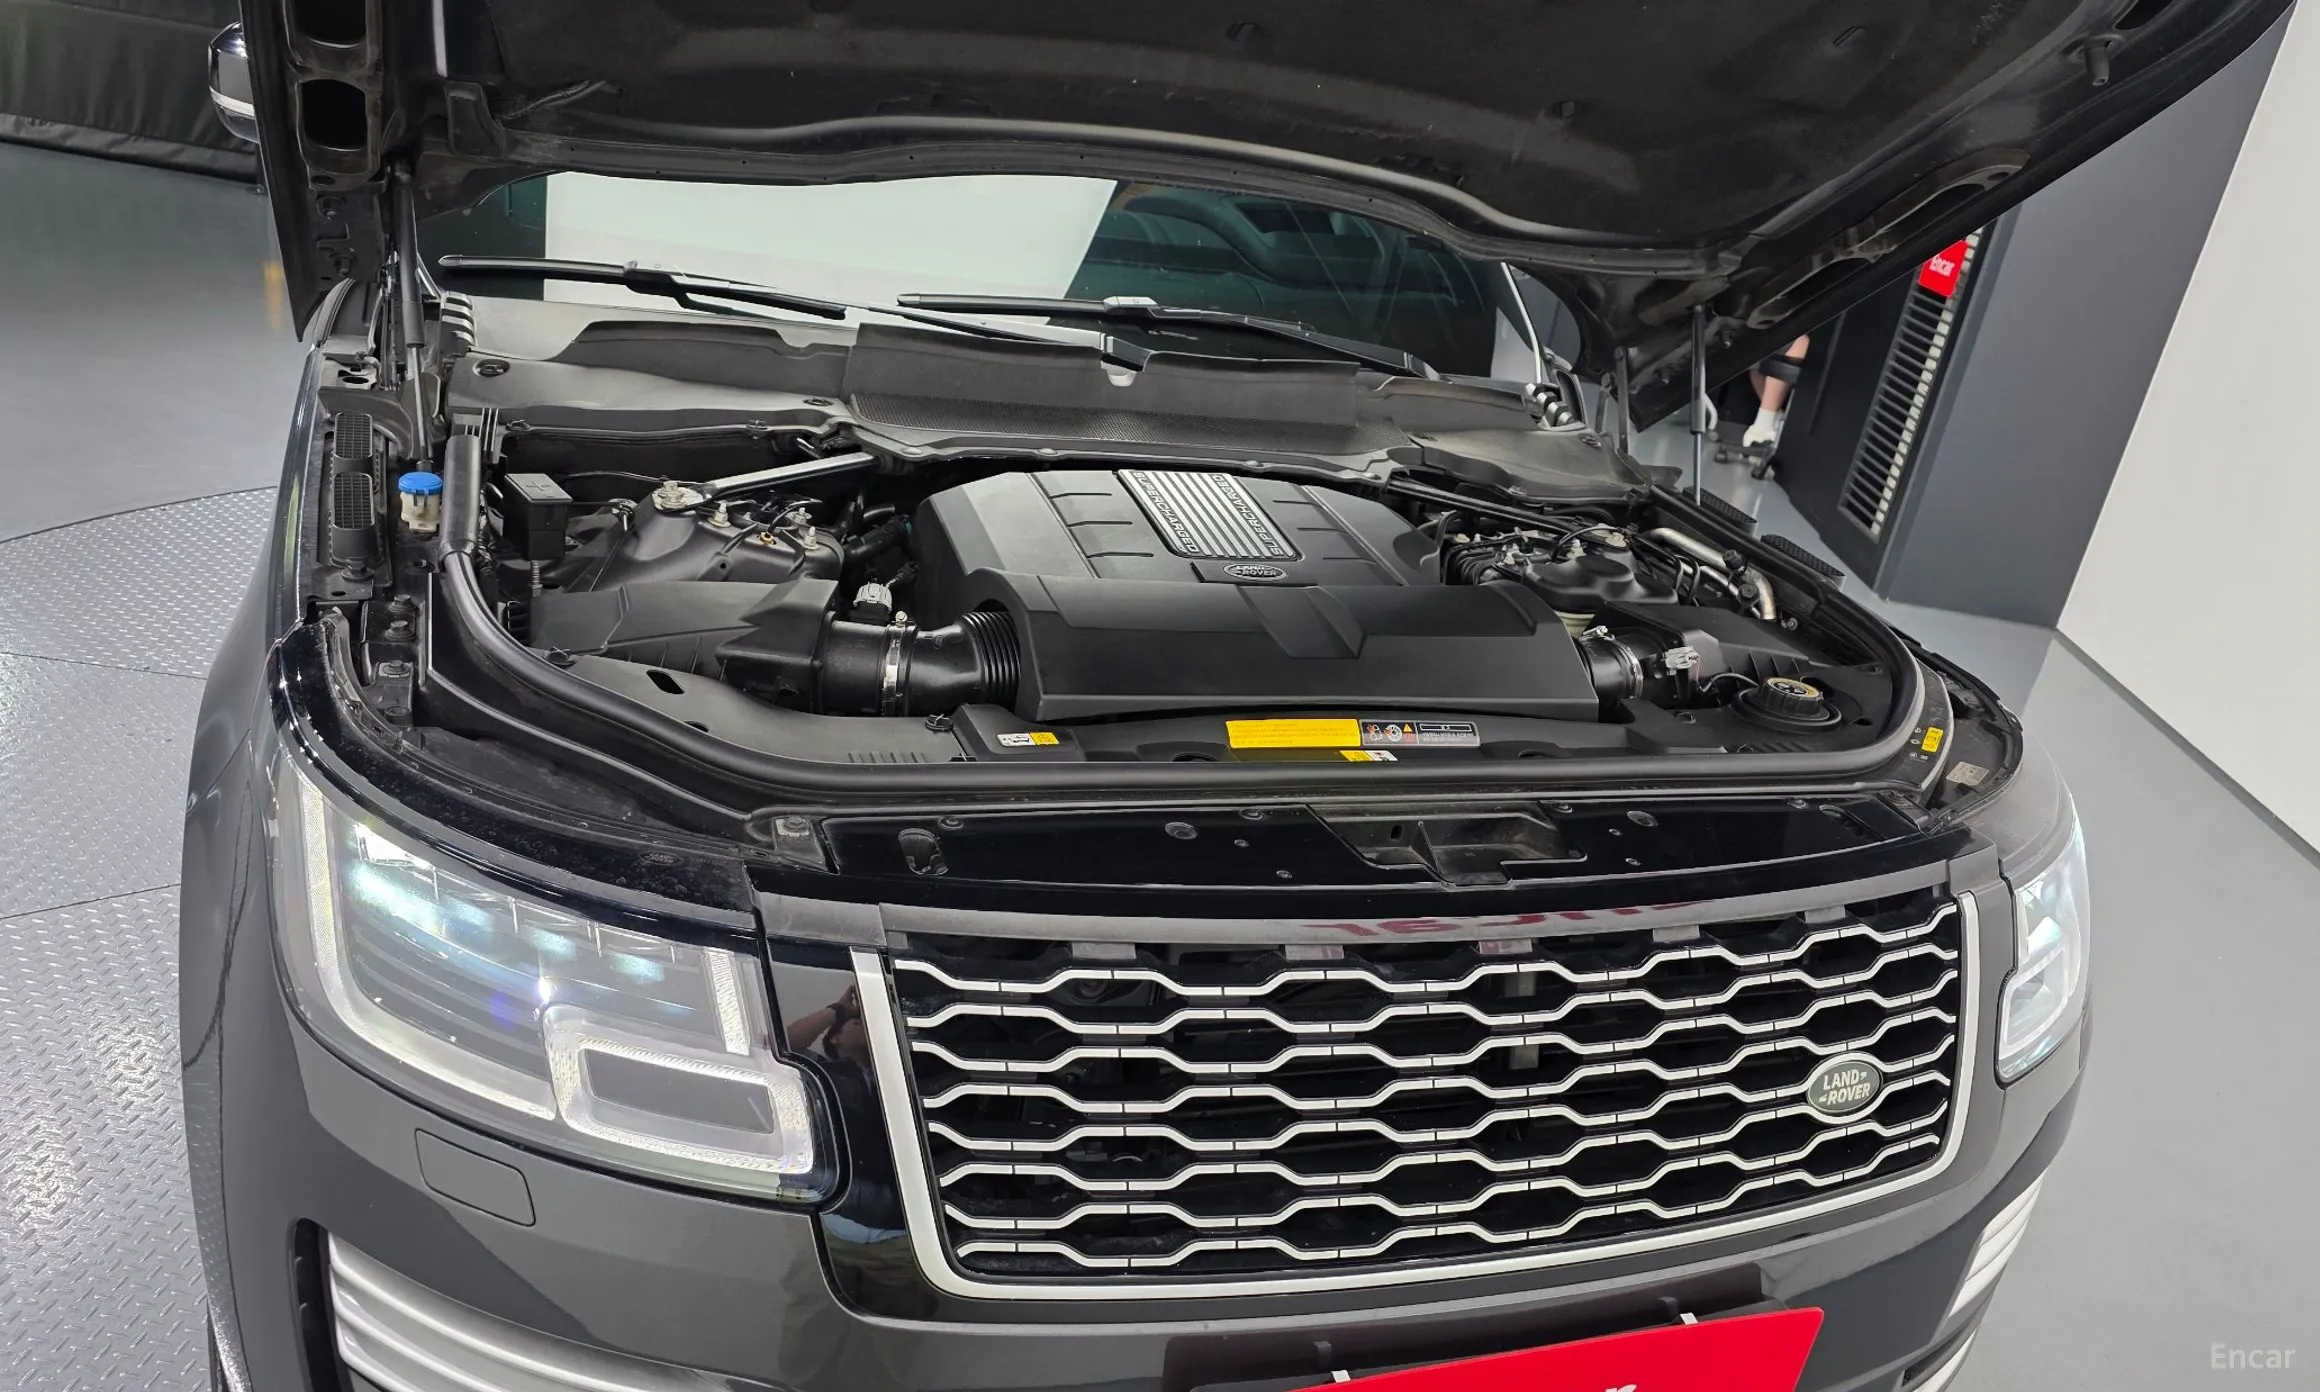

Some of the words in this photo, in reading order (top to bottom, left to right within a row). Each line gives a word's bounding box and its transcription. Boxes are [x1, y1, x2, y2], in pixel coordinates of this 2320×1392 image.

[1132, 471, 1200, 553] SUPERCHARGED
[1212, 473, 1284, 557] SUPERCHARGED
[1823, 1069, 1859, 1091] LAND
[1826, 1082, 1871, 1106] ROVER
